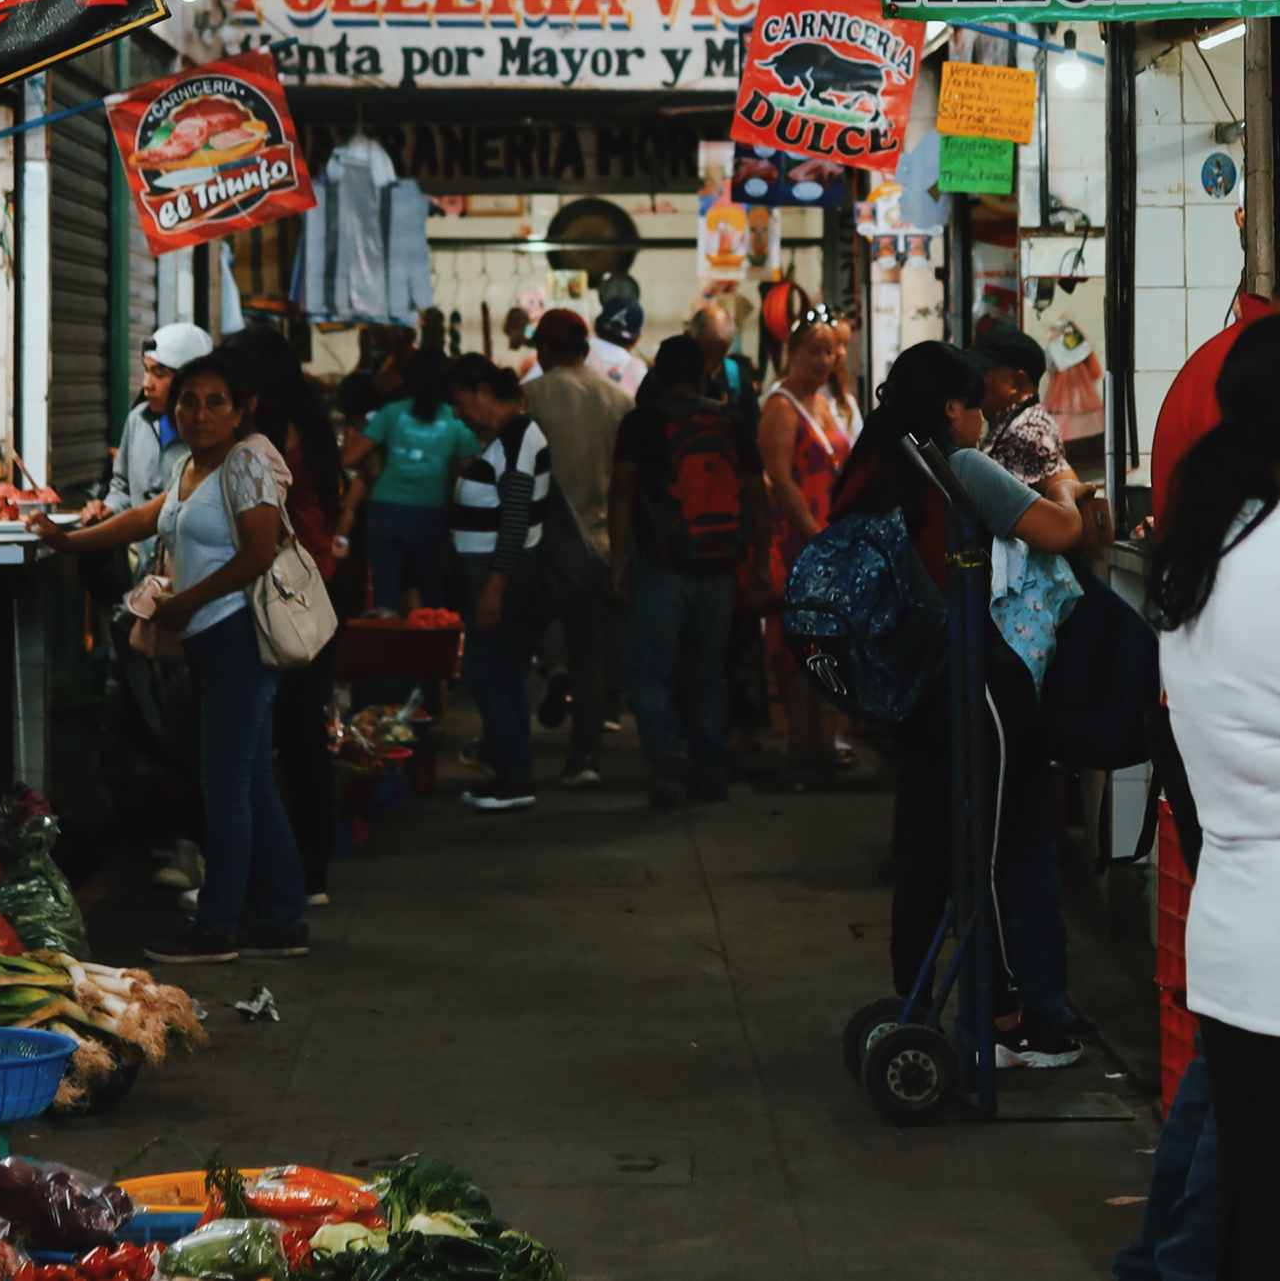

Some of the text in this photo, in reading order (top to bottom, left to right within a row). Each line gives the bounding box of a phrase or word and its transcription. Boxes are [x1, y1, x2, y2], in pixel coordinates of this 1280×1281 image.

[402, 41, 483, 87] por
[500, 35, 647, 86] Mayor
[664, 46, 693, 86] y
[762, 8, 915, 79] CARNICERIA
[151, 79, 239, 119] CARNICERIA
[739, 89, 898, 156] DULCE
[192, 156, 289, 211] Triunfo
